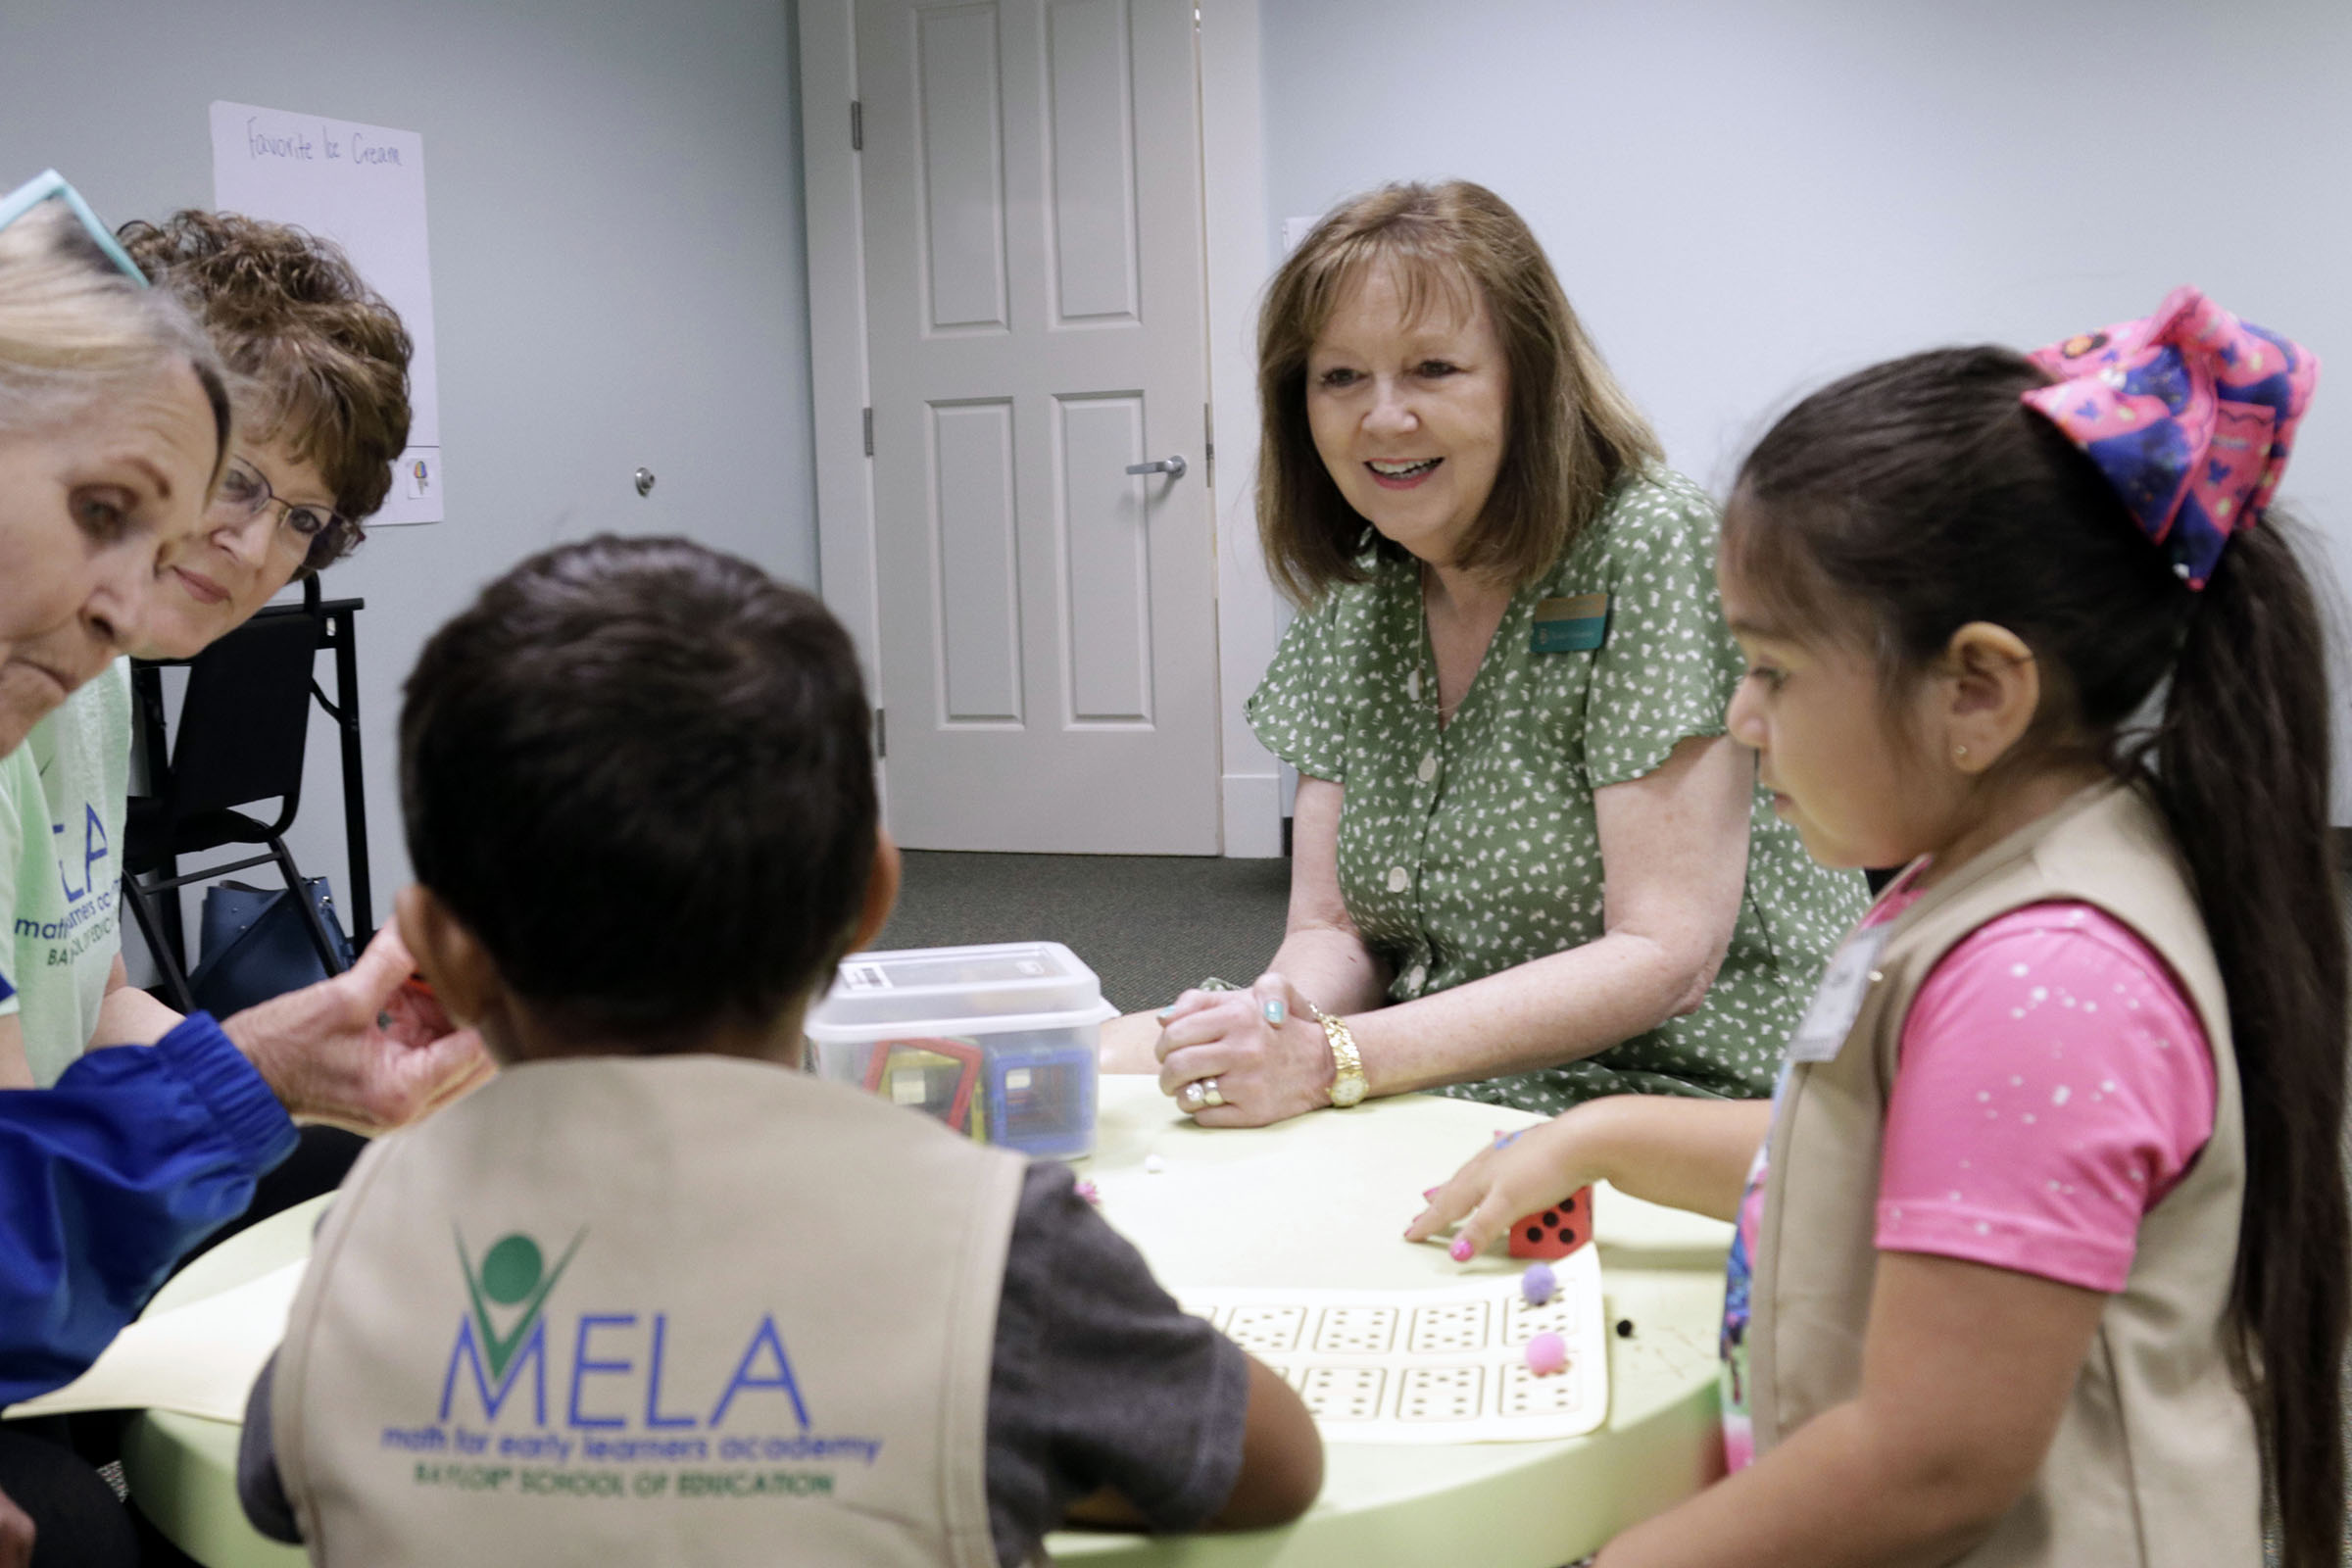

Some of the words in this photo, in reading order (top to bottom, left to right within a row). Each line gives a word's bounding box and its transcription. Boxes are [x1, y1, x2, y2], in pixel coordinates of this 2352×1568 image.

[247, 117, 314, 160] Favorite
[353, 132, 403, 167] Cream
[438, 1311, 812, 1428] MELA
[381, 1426, 446, 1452] math
[456, 1427, 489, 1456] for
[499, 1435, 571, 1465] early
[583, 1433, 708, 1461] learners
[718, 1435, 882, 1467] academy
[520, 1466, 625, 1496] SCHOOL
[633, 1470, 668, 1498] OF
[677, 1470, 834, 1498] EDUCATION
